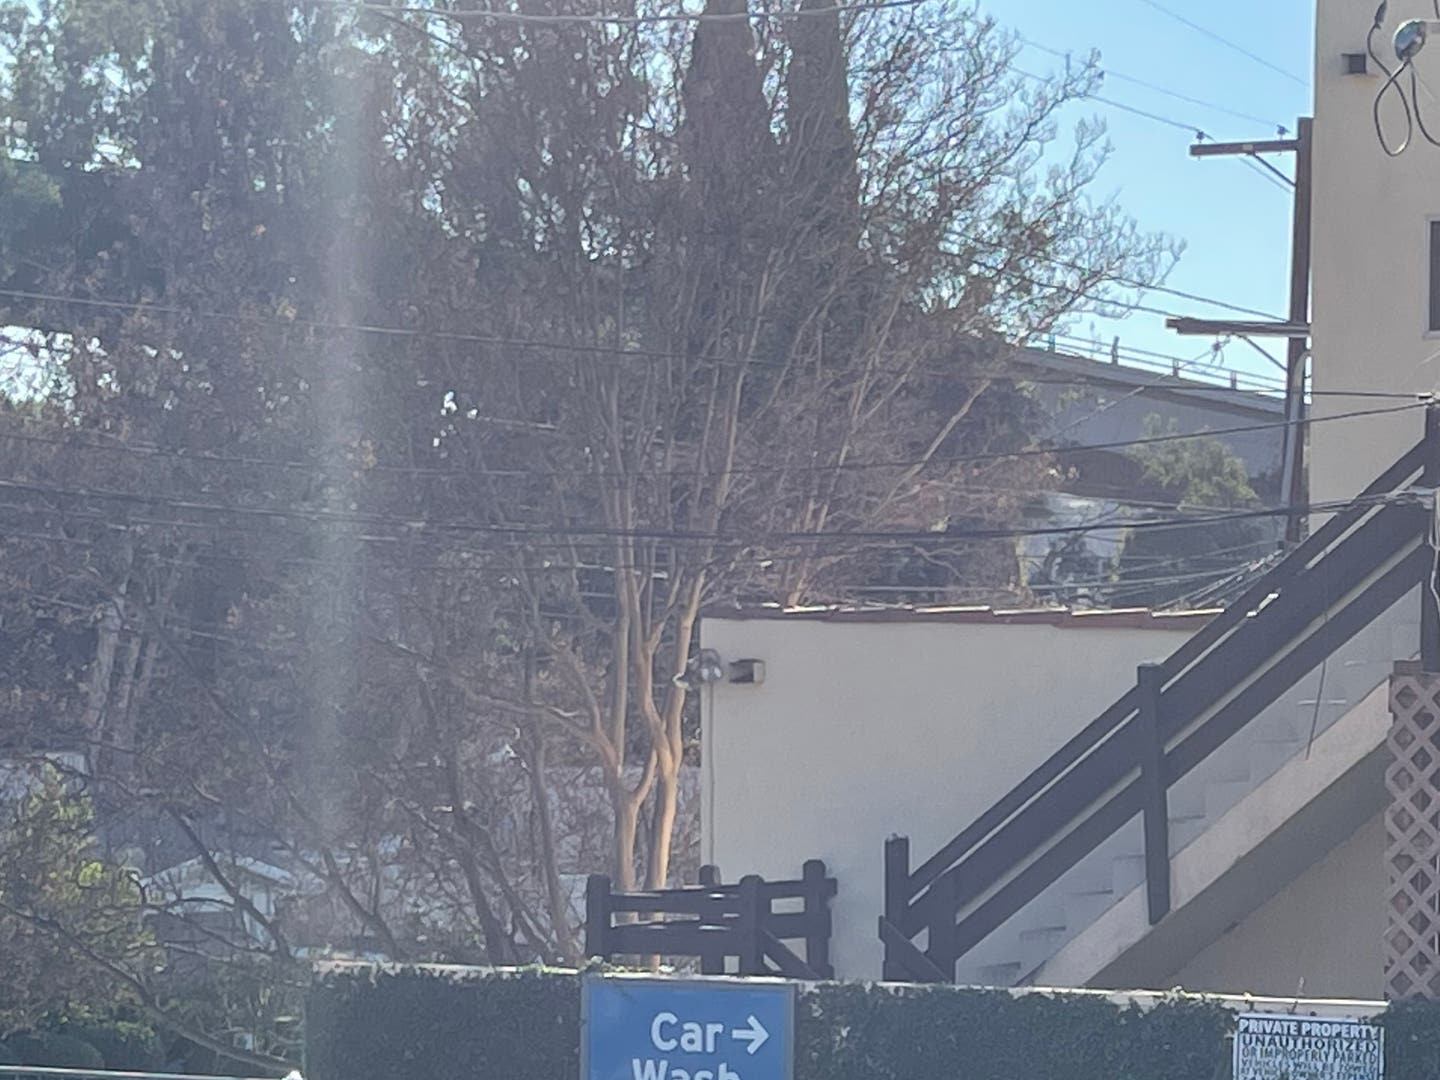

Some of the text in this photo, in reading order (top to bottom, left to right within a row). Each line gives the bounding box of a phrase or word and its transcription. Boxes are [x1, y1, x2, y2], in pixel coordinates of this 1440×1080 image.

[651, 1012, 724, 1053] Car
[1239, 1018, 1378, 1040] PRIVATE PROPERTY
[1243, 1034, 1376, 1052] UNAUTHORIZED
[1242, 1046, 1256, 1058] OR
[1260, 1047, 1329, 1062] IMPROPERLY
